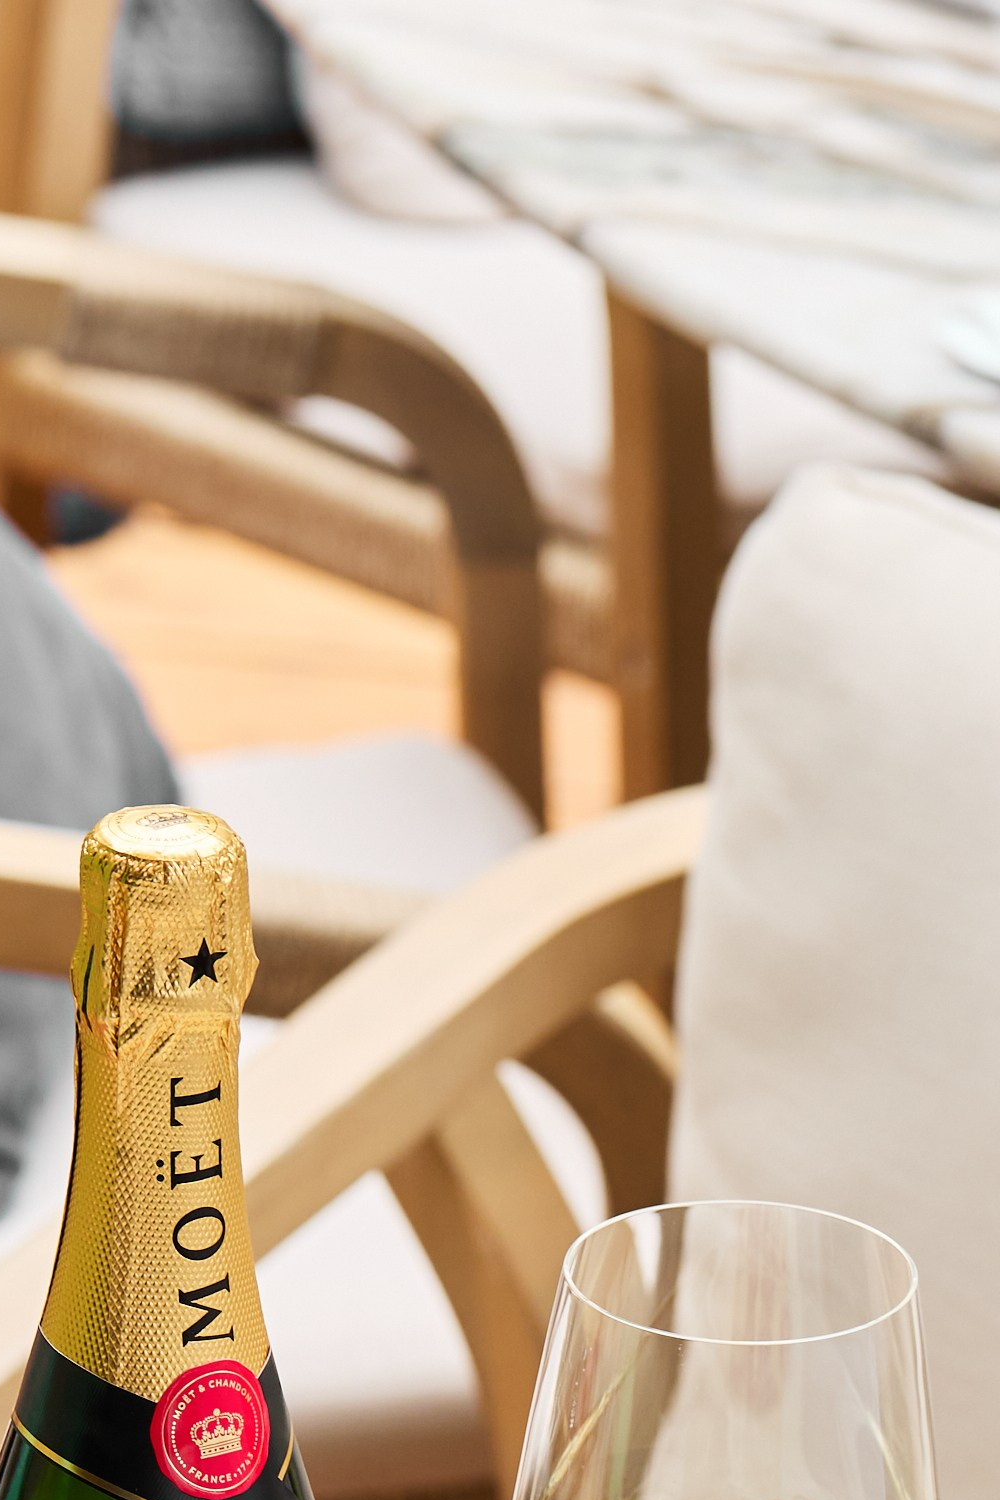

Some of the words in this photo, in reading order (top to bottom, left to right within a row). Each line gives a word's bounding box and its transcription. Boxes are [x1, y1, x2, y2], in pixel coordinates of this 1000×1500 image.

[156, 1077, 235, 1347] MOËT
[198, 1384, 206, 1393] &
[208, 1378, 252, 1403] CHANDON
[188, 1466, 233, 1484] FRANCE
